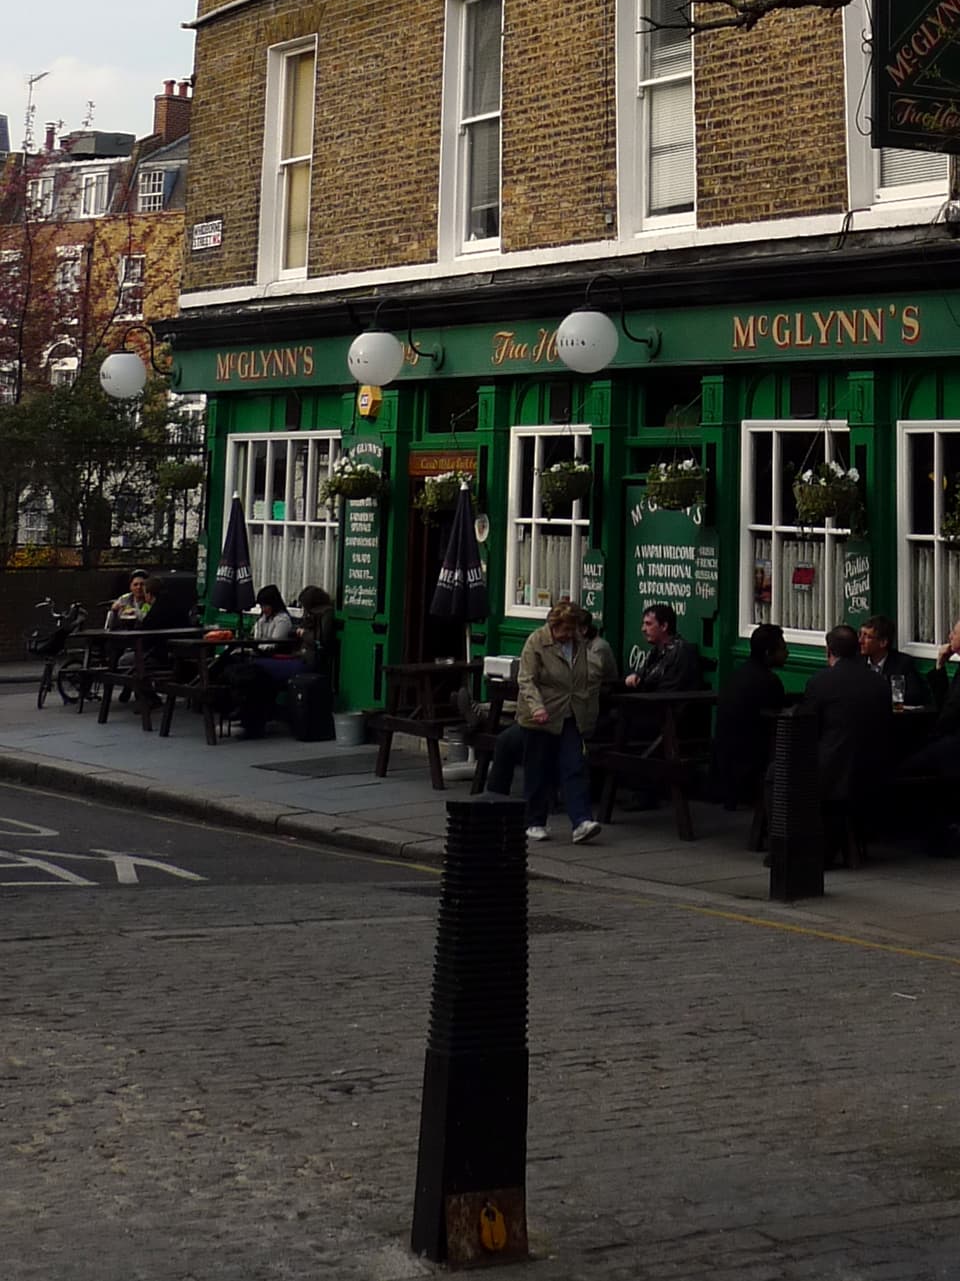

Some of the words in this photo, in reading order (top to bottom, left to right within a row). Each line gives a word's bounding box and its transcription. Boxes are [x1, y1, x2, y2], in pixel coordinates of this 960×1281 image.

[733, 303, 921, 350] McGLYNN'S
[216, 345, 314, 381] McGLYNN'S
[635, 545, 641, 558] A
[662, 545, 696, 560] WELCOME
[583, 563, 604, 577] MALT
[636, 563, 645, 577] IN
[647, 563, 692, 579] TRADITIONAL
[851, 597, 869, 609] FOR
